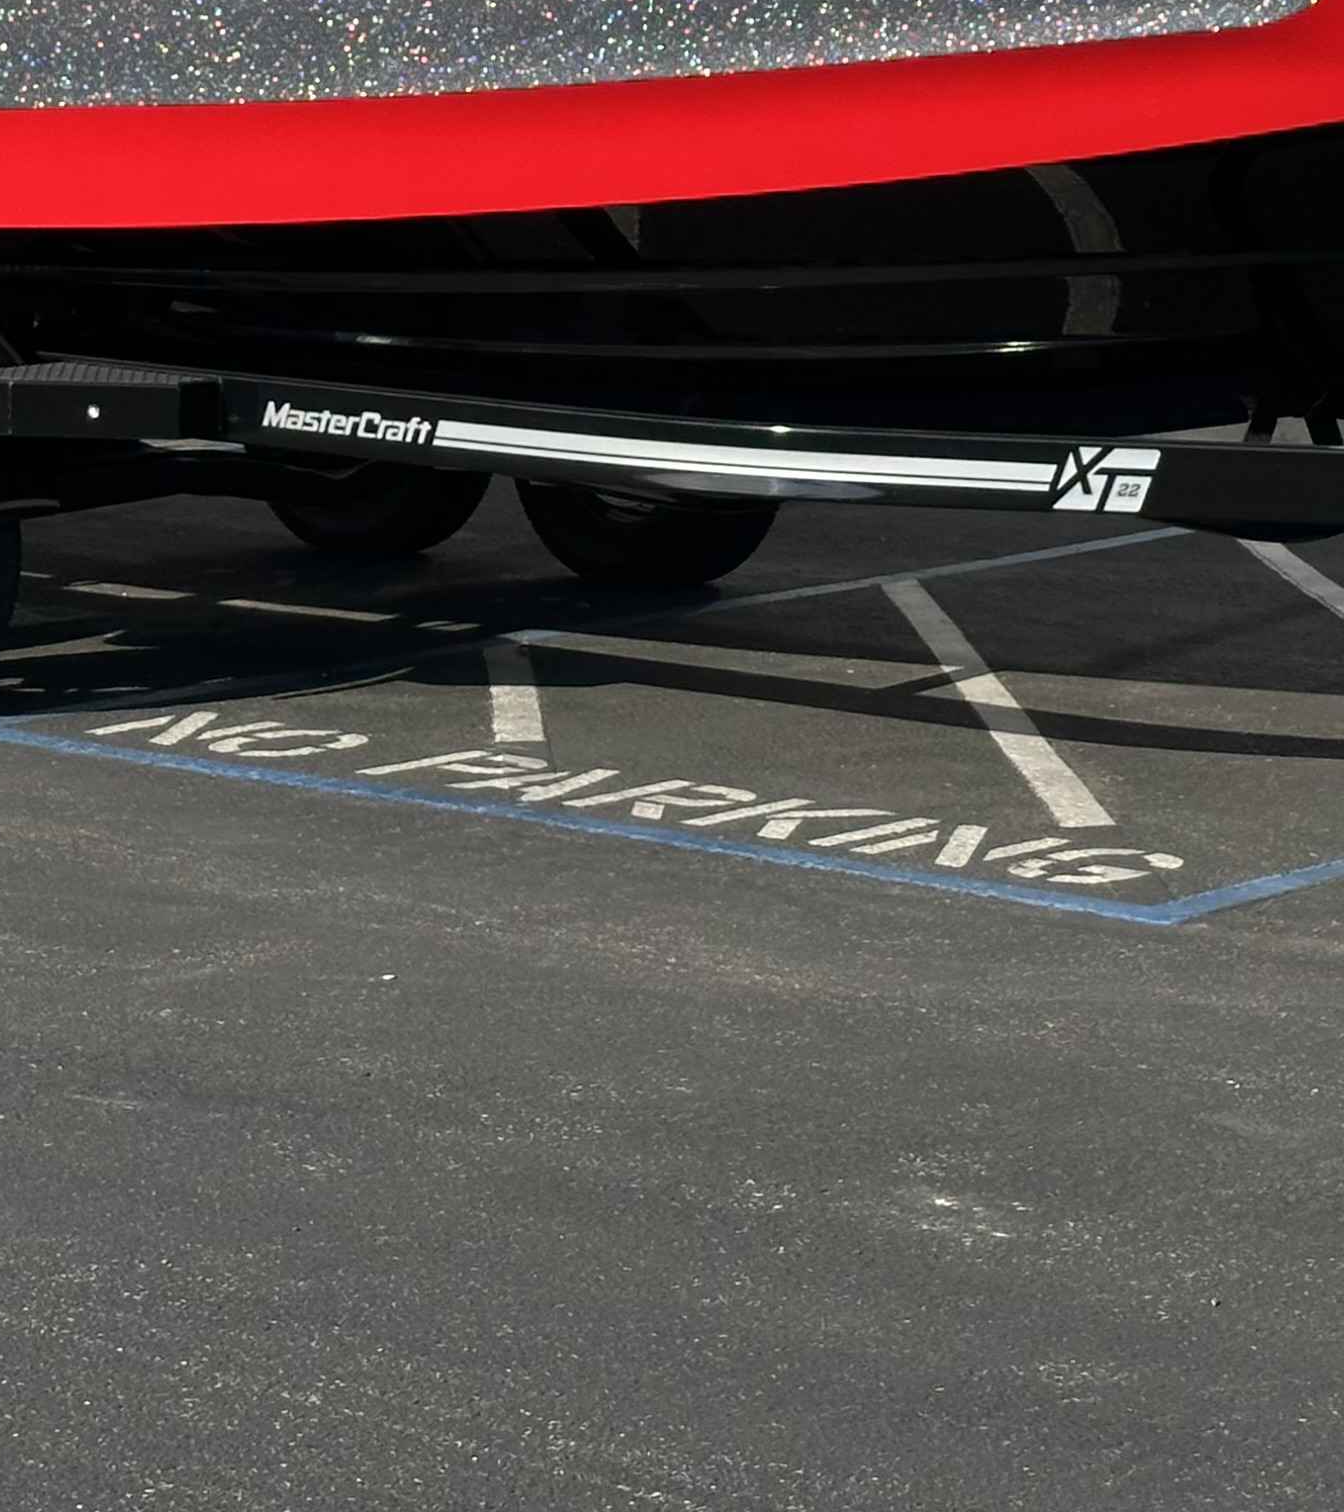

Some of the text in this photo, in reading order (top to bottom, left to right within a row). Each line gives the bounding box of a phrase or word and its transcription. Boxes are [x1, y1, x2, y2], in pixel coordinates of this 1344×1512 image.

[262, 400, 432, 446] MasterCraft
[1116, 481, 1143, 498] 22
[83, 710, 370, 758] NO
[354, 750, 1186, 885] PARKING
